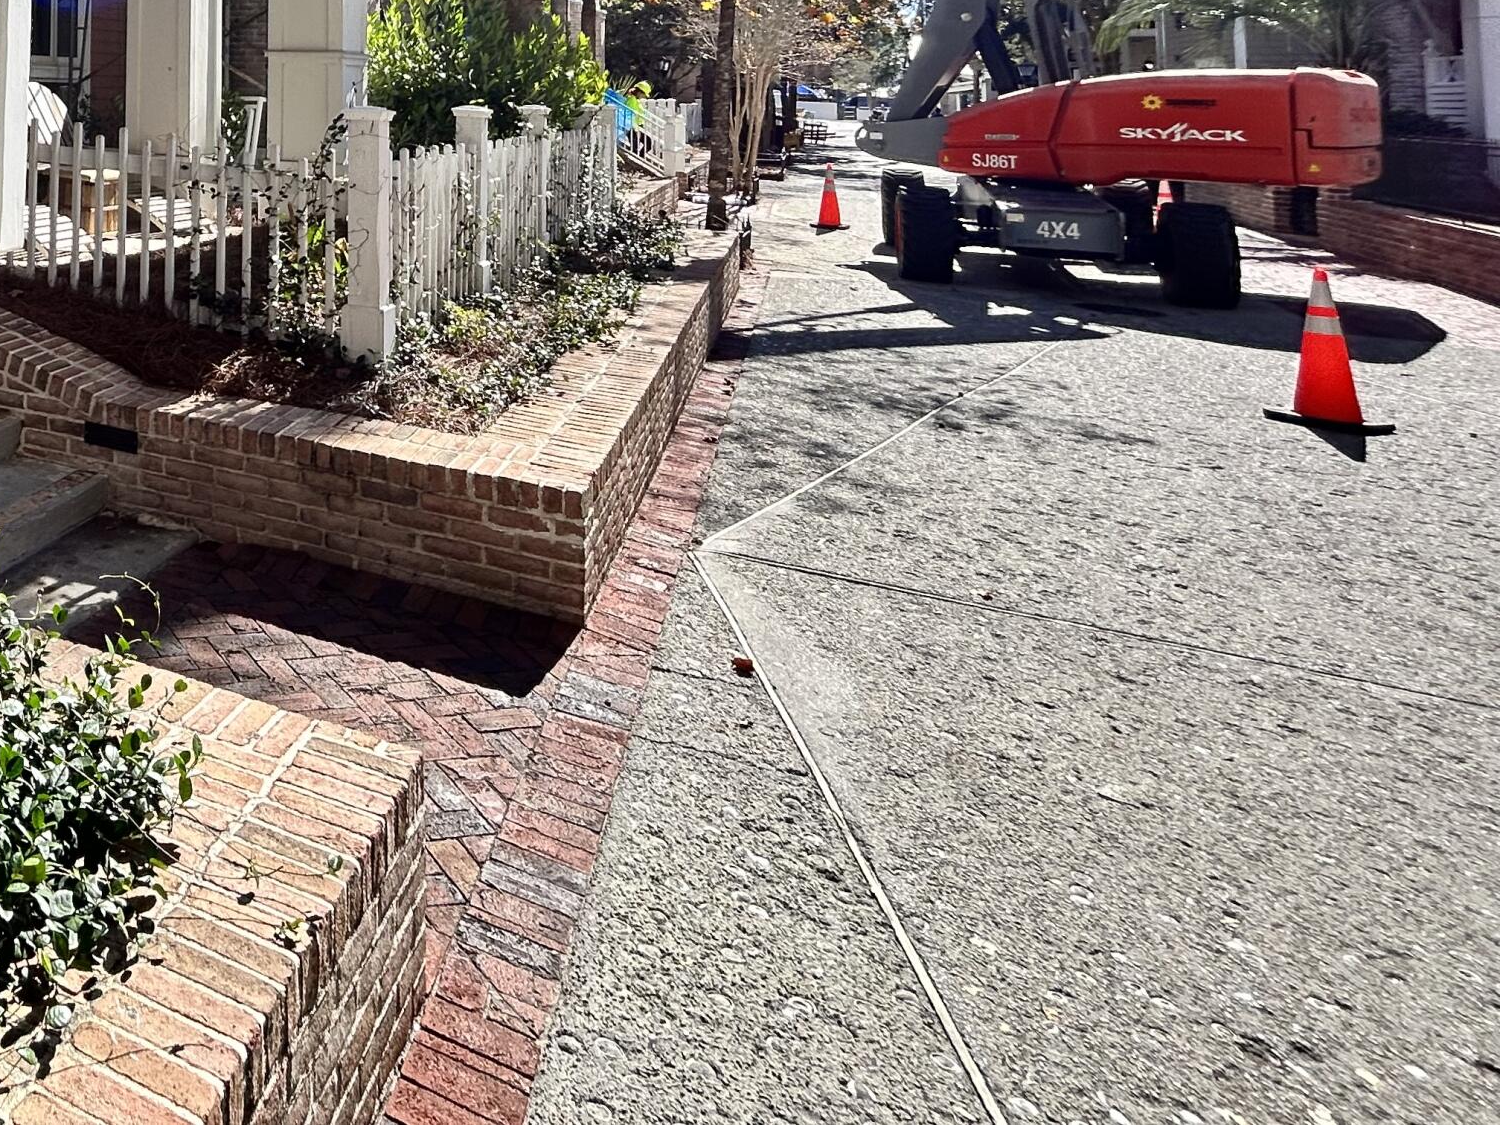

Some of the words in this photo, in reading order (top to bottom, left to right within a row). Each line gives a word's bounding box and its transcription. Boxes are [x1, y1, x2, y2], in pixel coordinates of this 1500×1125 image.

[1119, 122, 1249, 142] SKYJACK
[971, 153, 1018, 169] SJ86T
[1036, 221, 1080, 240] 4X4
